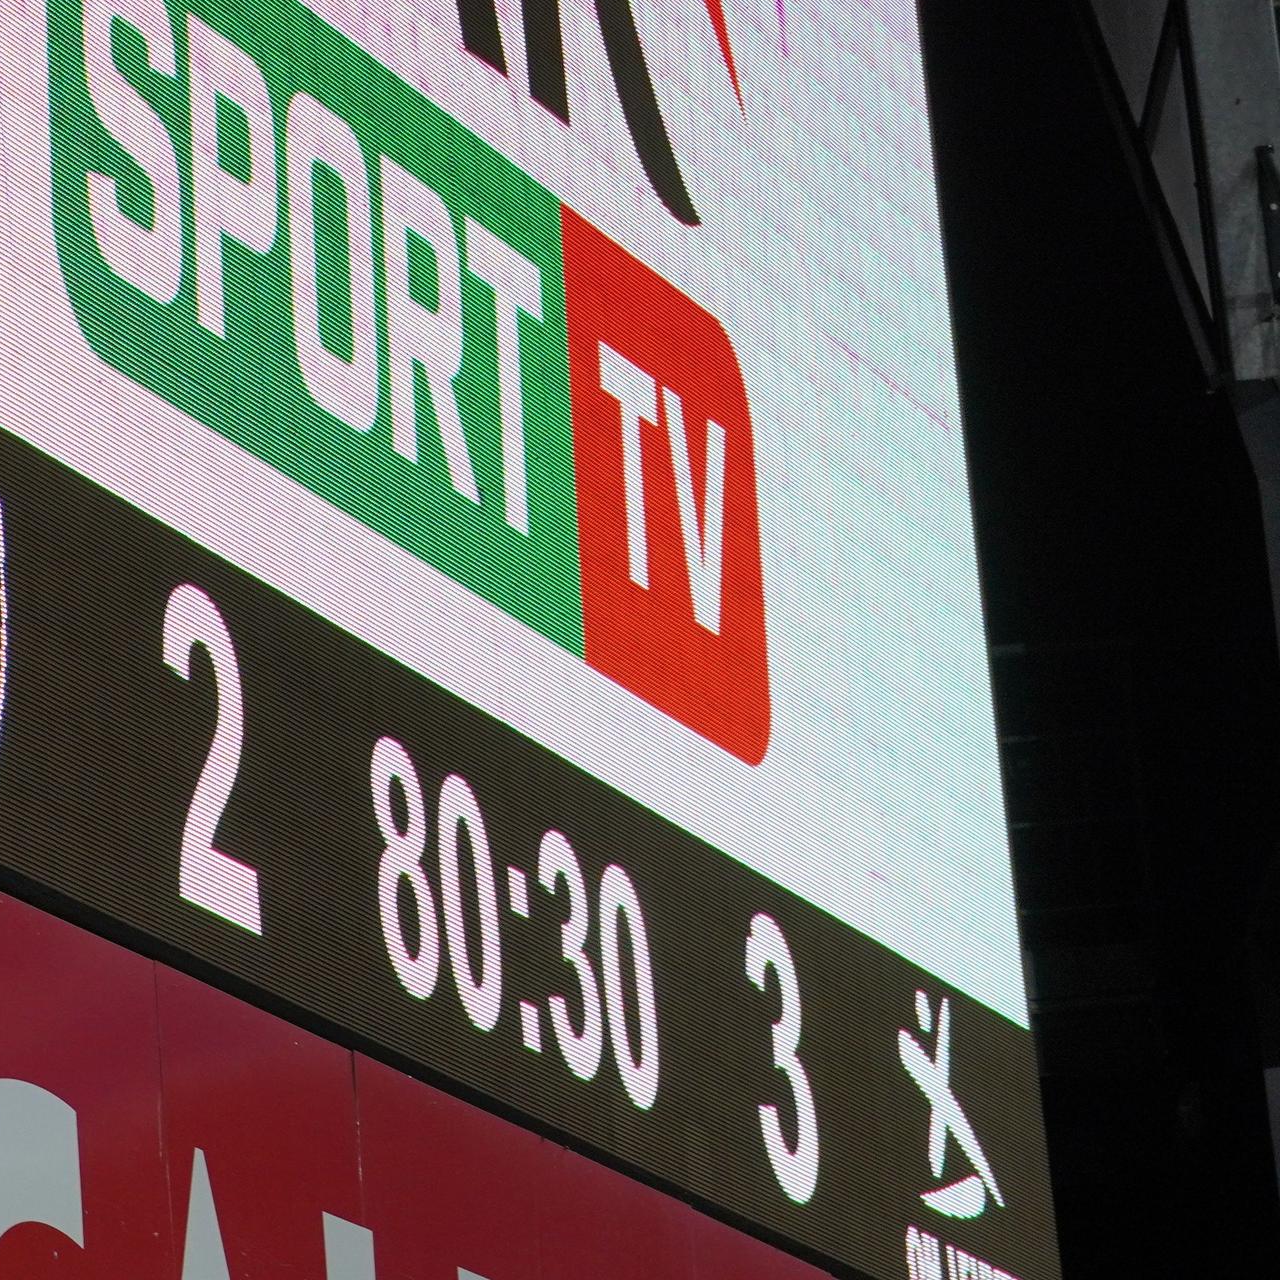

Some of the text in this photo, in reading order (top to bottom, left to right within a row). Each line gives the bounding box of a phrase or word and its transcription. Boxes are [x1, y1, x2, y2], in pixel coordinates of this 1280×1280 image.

[599, 342, 725, 637] TV
[163, 584, 262, 936] 2
[370, 737, 659, 1110] 80:30
[745, 913, 820, 1205] 3
